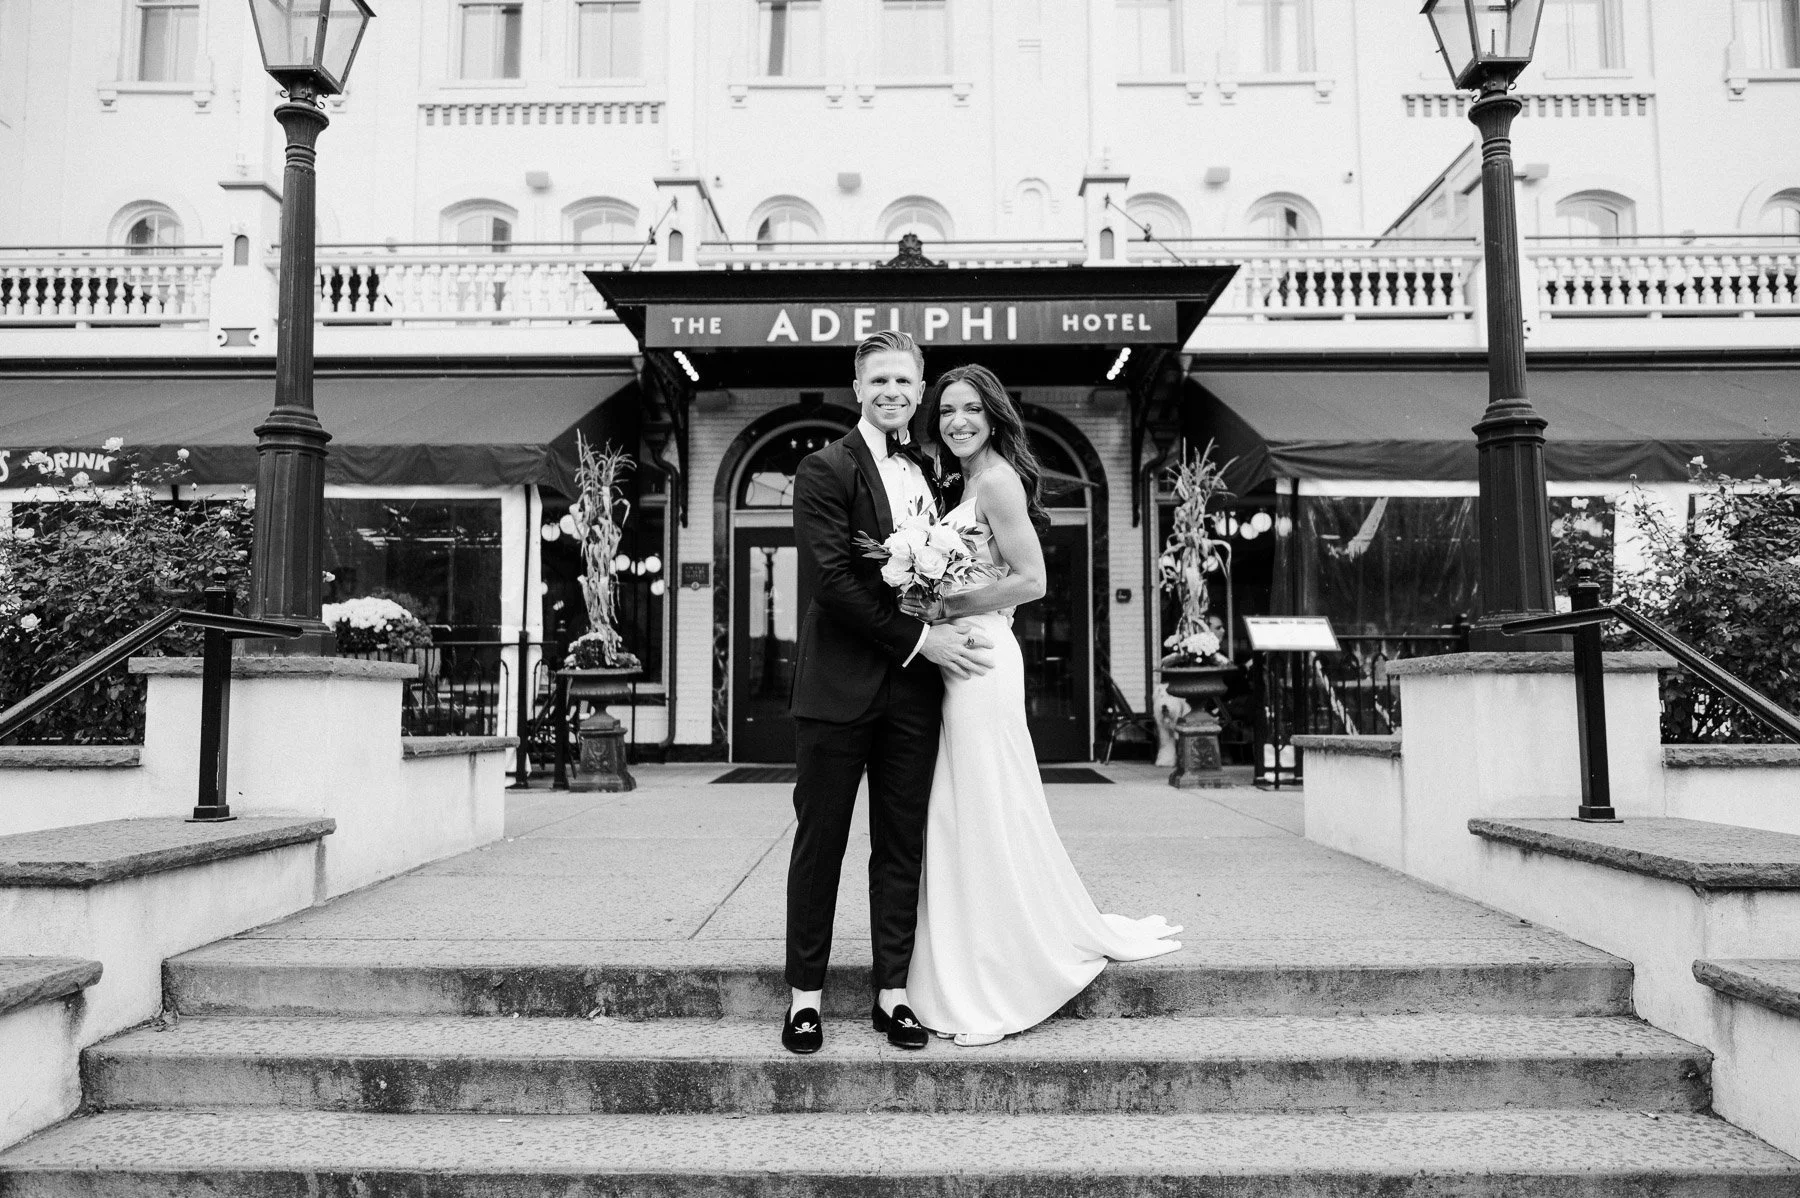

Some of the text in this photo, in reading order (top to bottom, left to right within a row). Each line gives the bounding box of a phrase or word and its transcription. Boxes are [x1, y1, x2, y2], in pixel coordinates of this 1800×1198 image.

[671, 306, 1152, 343] THE ADELPHI HOTEL
